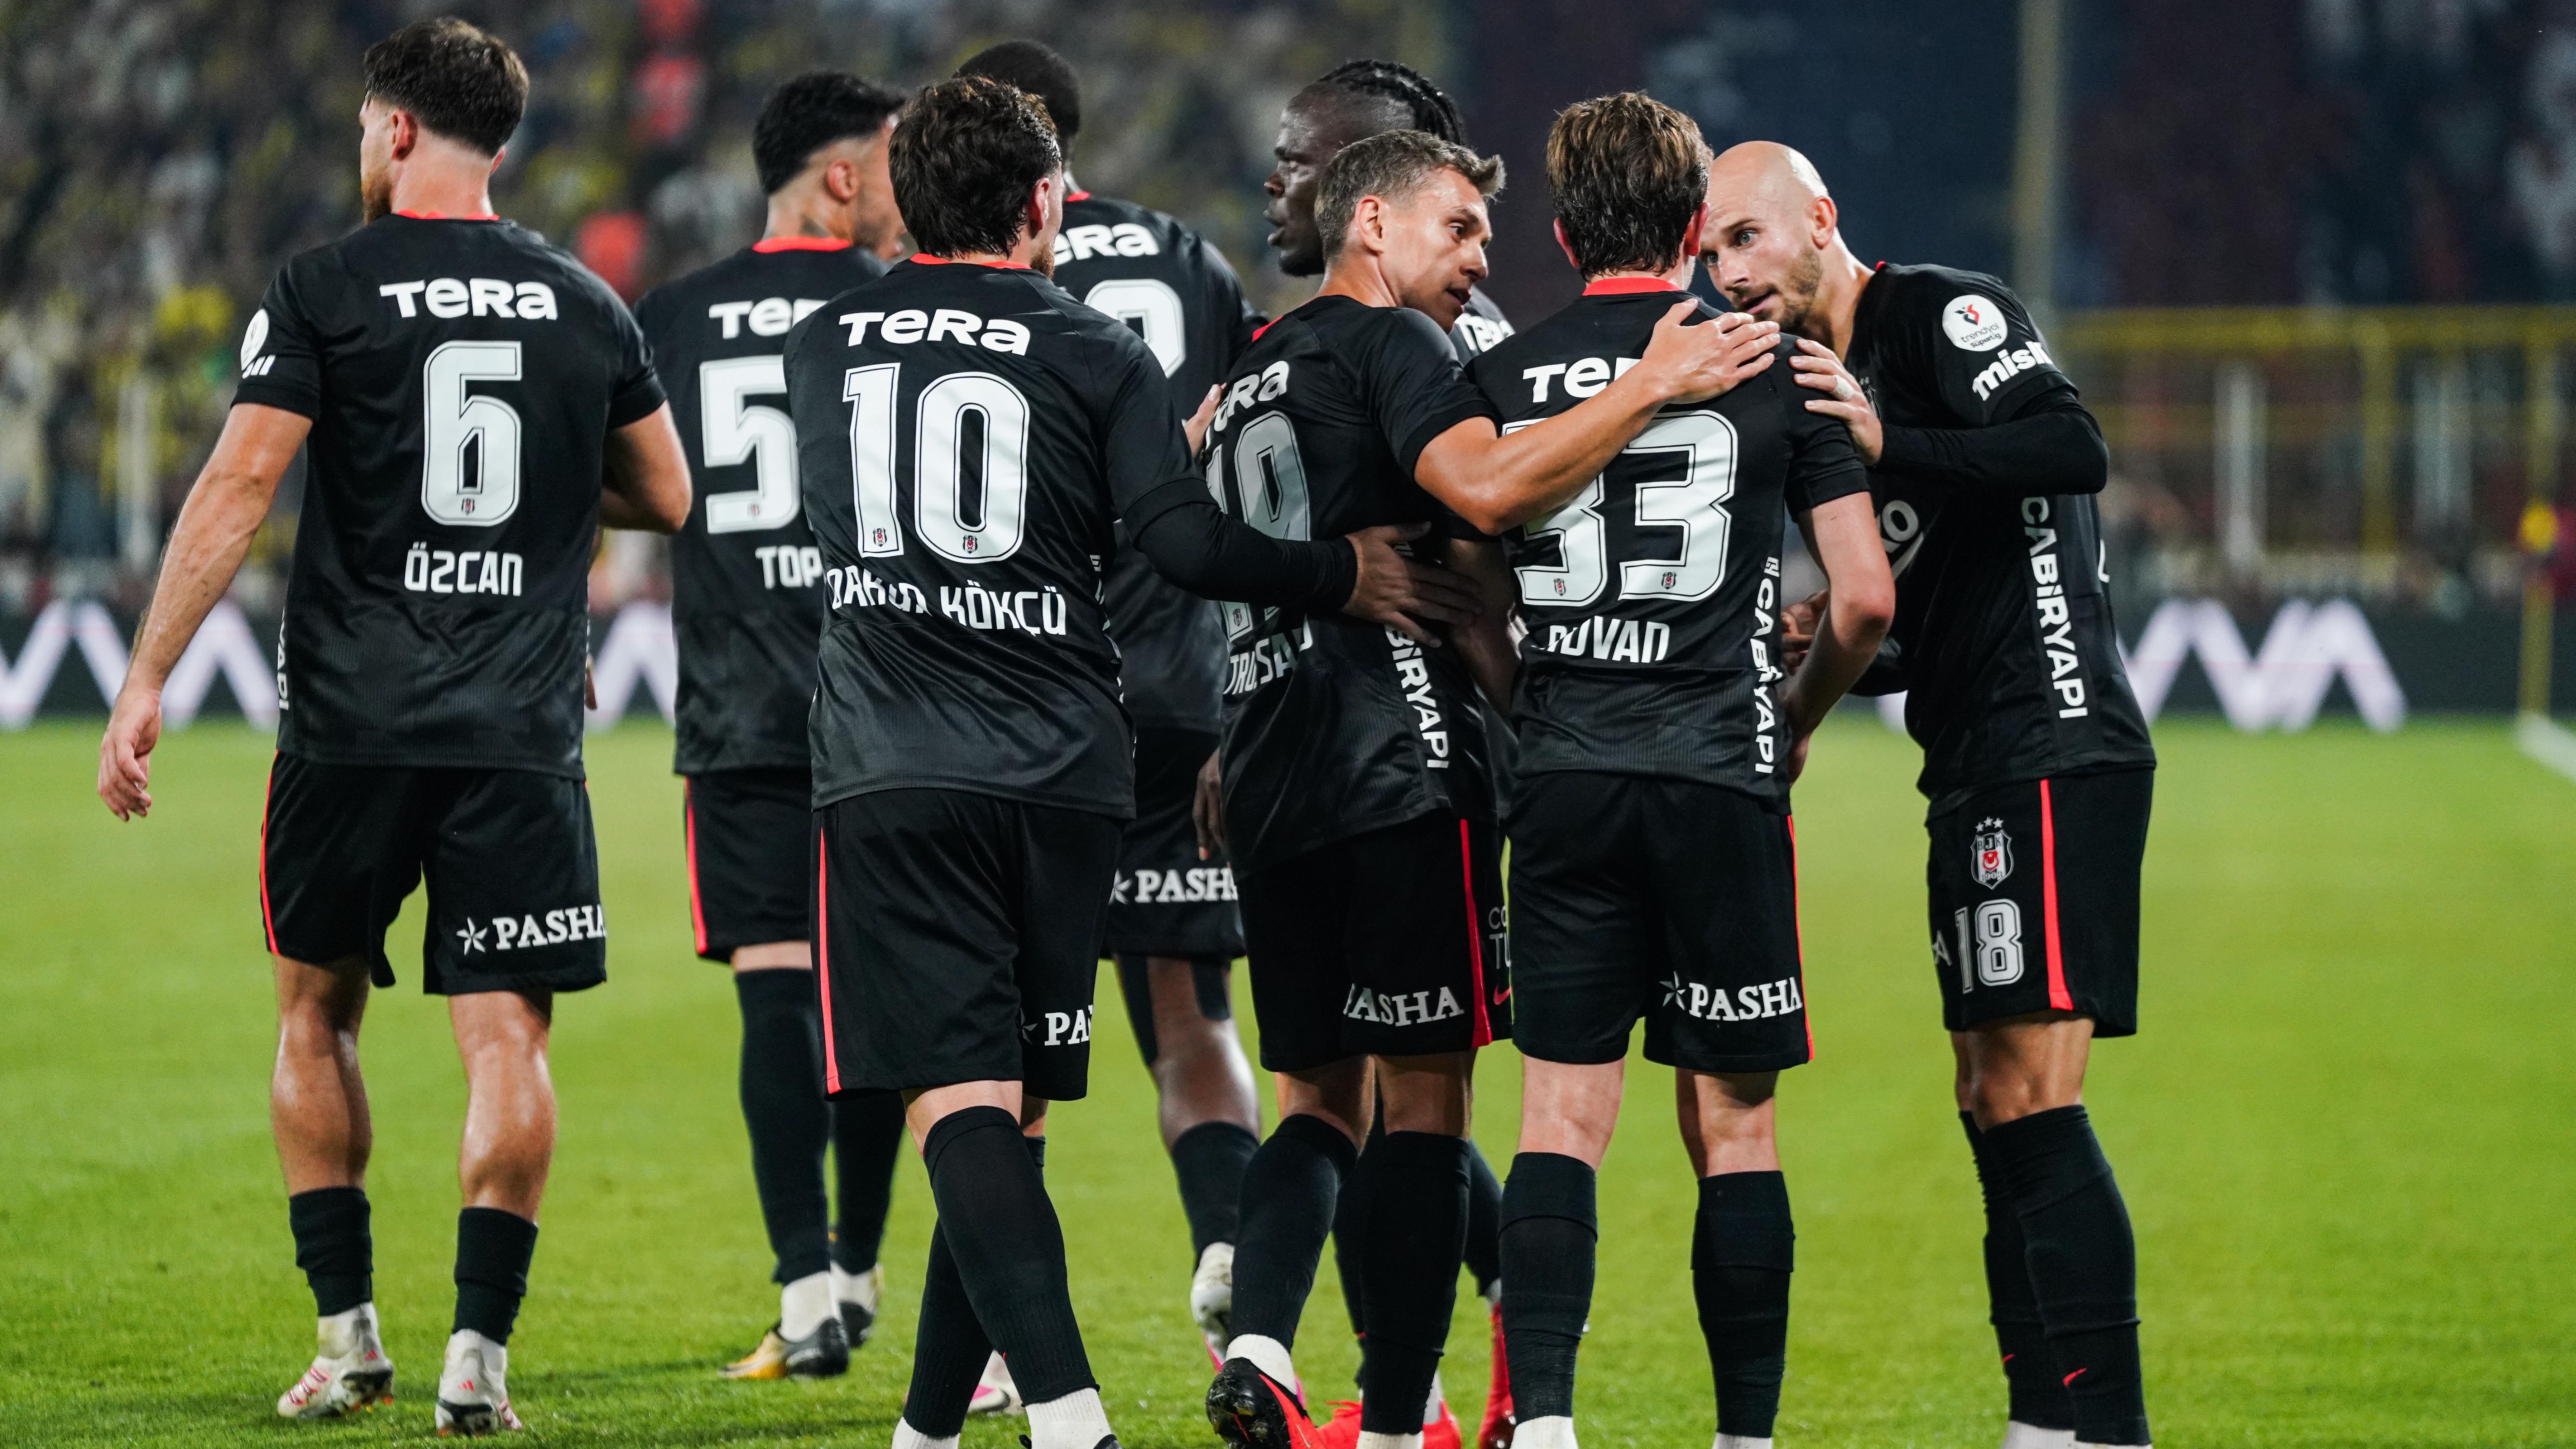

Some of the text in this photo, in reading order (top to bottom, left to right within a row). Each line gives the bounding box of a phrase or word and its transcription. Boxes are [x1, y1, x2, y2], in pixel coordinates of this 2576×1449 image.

[1054, 223, 1160, 266] eRa
[1961, 323, 1999, 342] trendyol
[421, 340, 522, 527] 6
[699, 354, 800, 534] 5
[842, 363, 1030, 563] 10
[1502, 409, 1738, 606] 33
[404, 541, 523, 596] ÖZCAN
[940, 579, 1066, 637] KÖKÇÜ
[1954, 898, 2024, 994] 18
[1343, 983, 1465, 1027] ASHA
[1688, 977, 1803, 1021] PASHA
